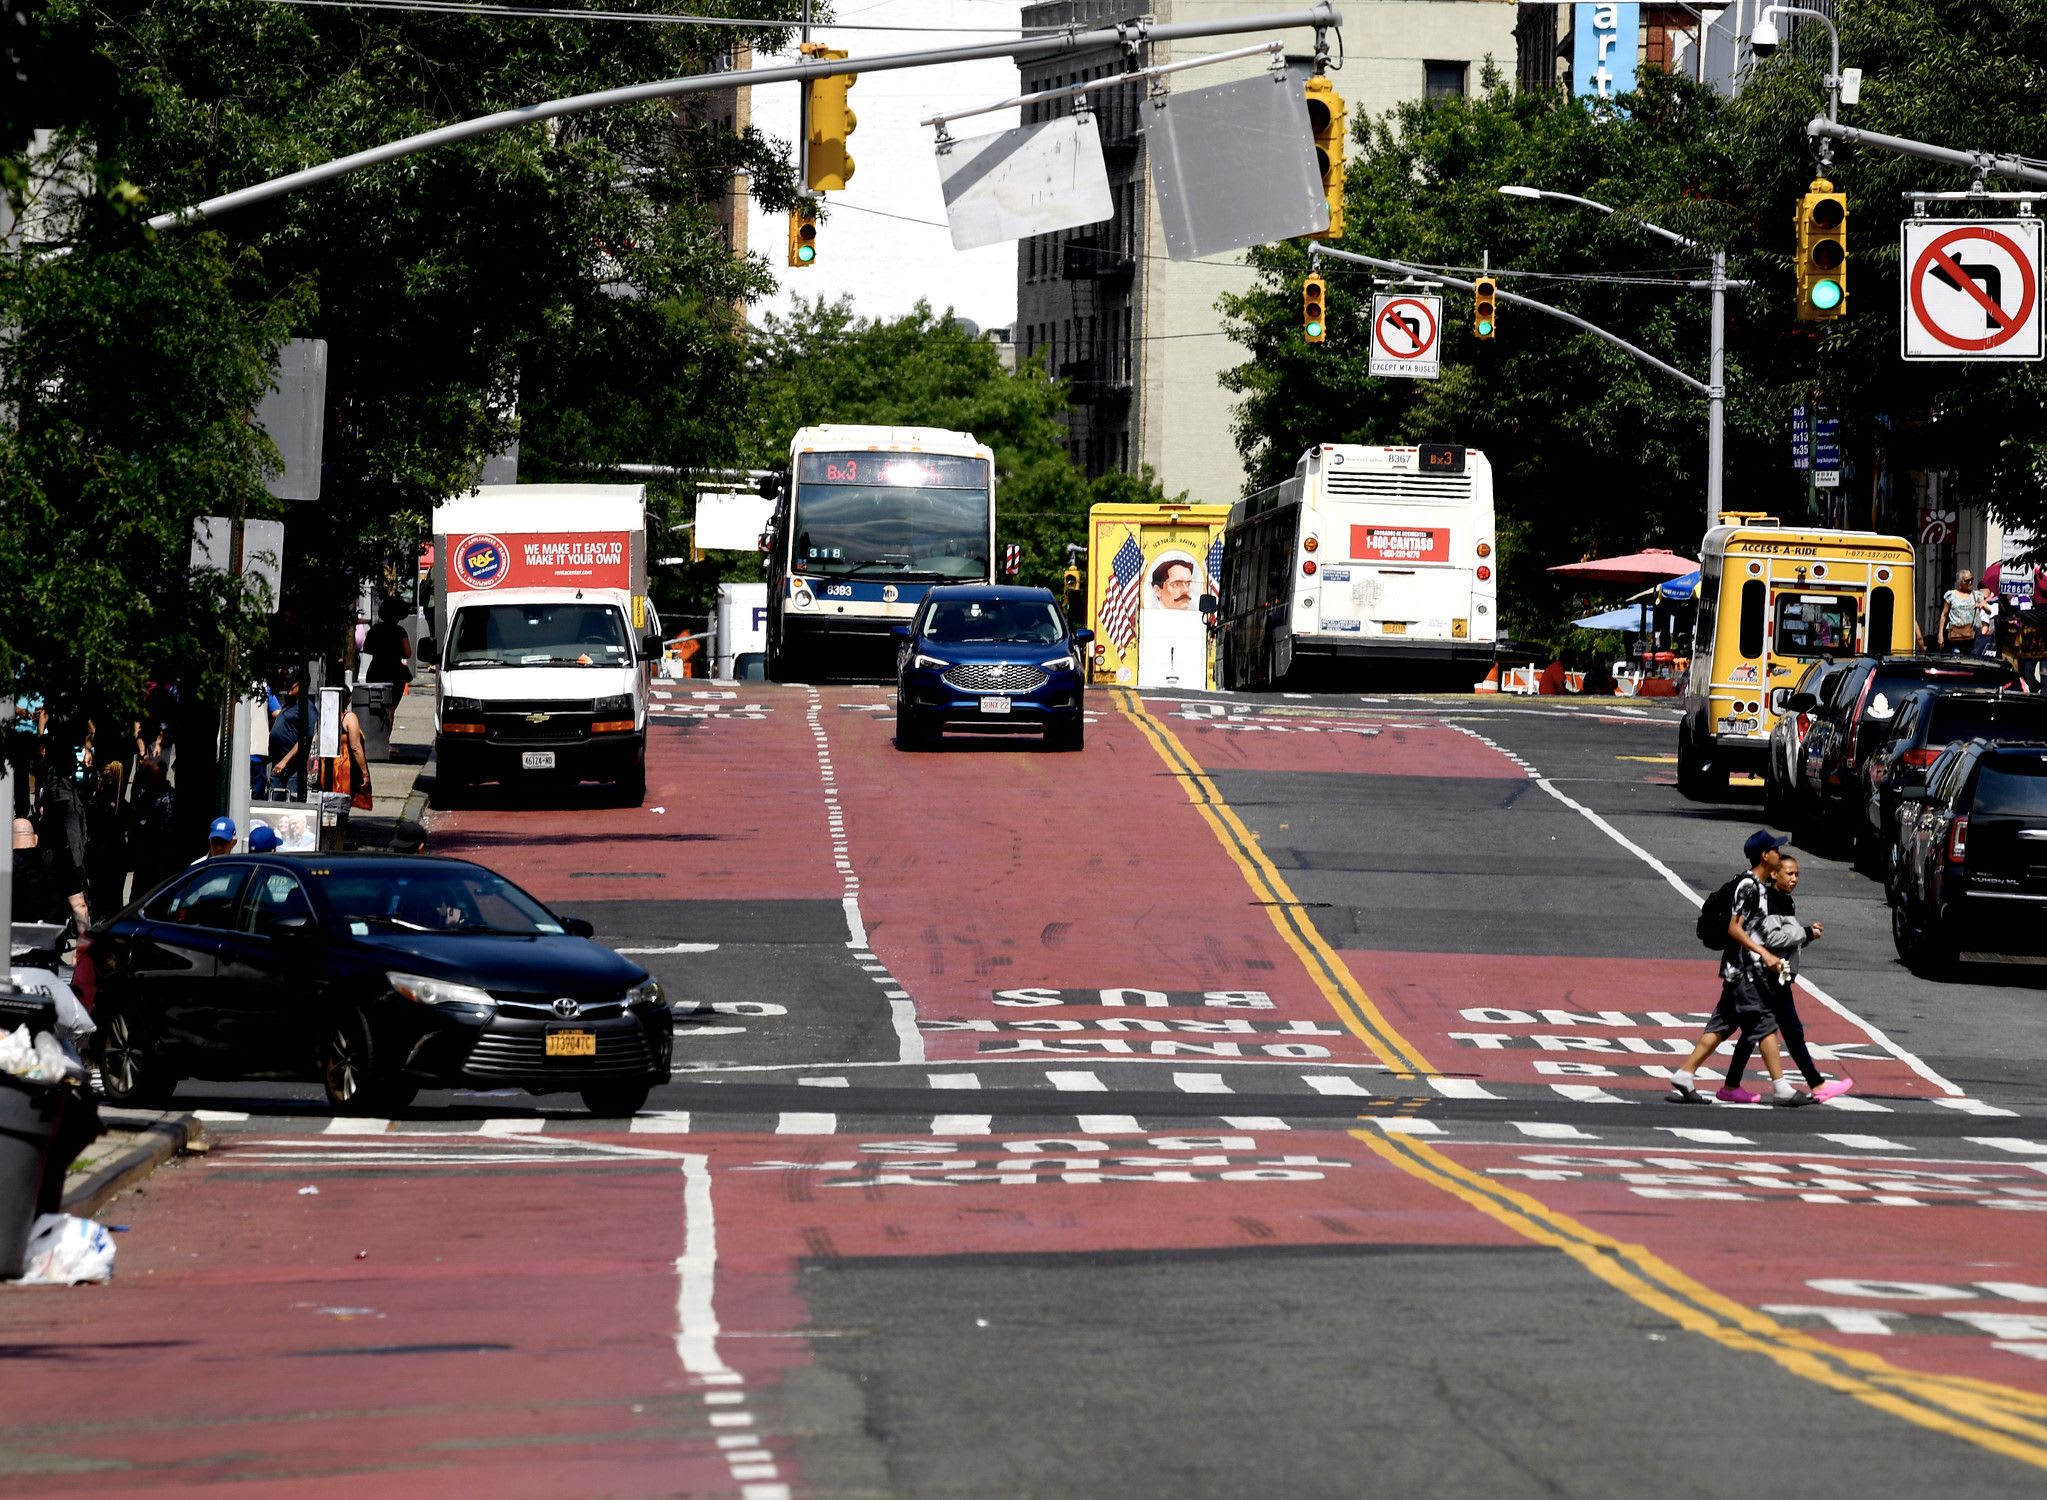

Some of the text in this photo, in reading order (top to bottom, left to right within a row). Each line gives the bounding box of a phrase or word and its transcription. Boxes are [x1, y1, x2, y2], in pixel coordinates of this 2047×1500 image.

[1372, 363, 1397, 371] EXCEPT
[1415, 365, 1436, 373] BUSES
[1793, 432, 1809, 442] Bx13
[1388, 454, 1411, 464] 8367
[1430, 451, 1453, 465] Bx3
[827, 461, 857, 480] Bx3
[524, 542, 622, 555] WE MAKE IT EASY TO
[1366, 536, 1433, 551] 1-800-CANTASO
[1742, 544, 1818, 556] ACCESS-A-RIDE
[468, 550, 495, 568] RAC
[526, 553, 620, 565] MAKE IT YOUR OWN
[1845, 550, 1901, 559] 1-877-337-2017
[827, 585, 852, 596] 8393
[992, 989, 1277, 1010] BUS
[1459, 1007, 1714, 1027] ONL
[916, 1017, 1342, 1036] TRUCK
[978, 1038, 1333, 1058] ONLY
